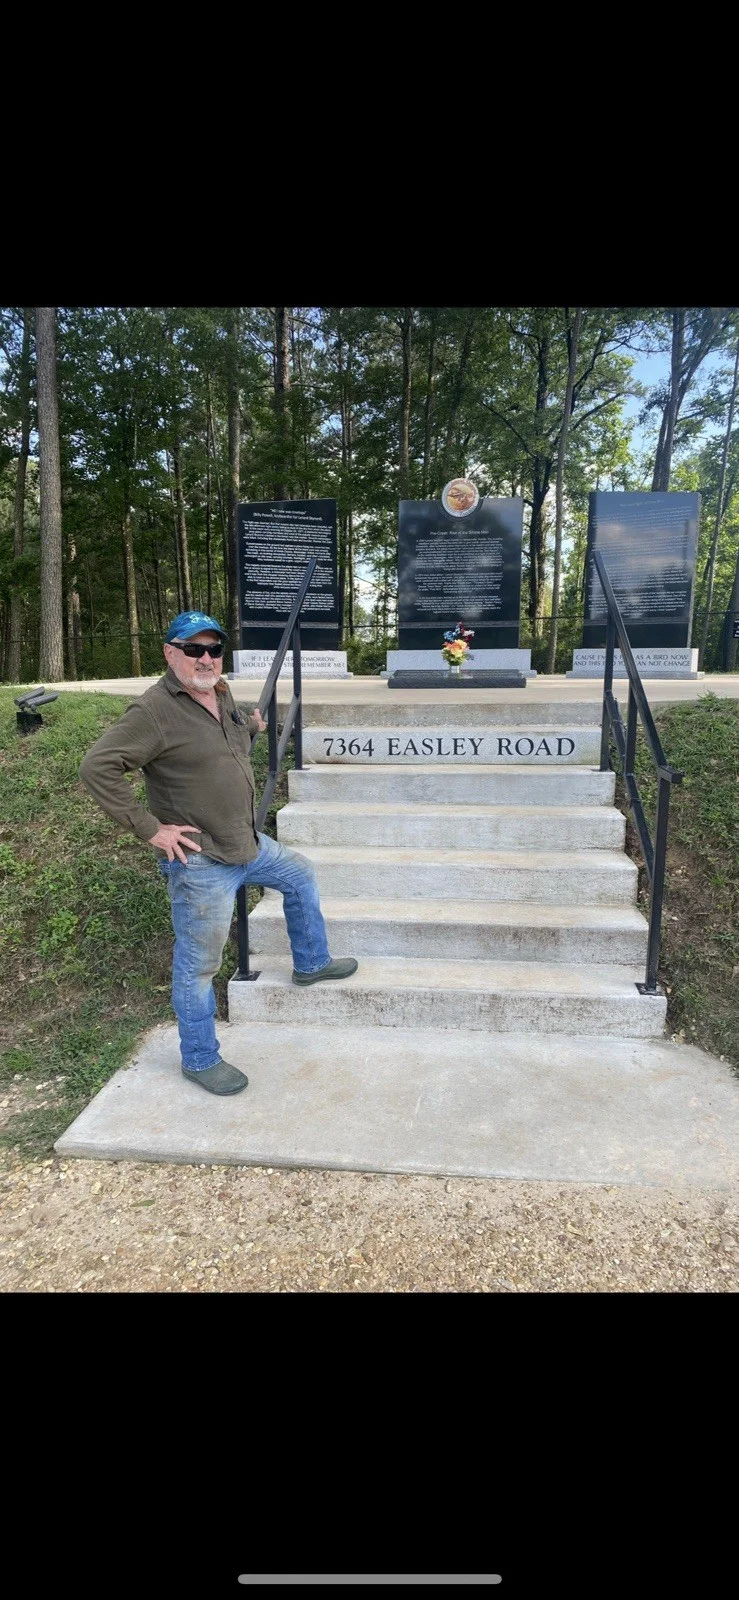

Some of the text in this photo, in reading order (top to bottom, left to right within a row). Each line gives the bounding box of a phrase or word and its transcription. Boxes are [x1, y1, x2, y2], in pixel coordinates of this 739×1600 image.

[323, 738, 576, 757] 7364 EASLEY ROAD
